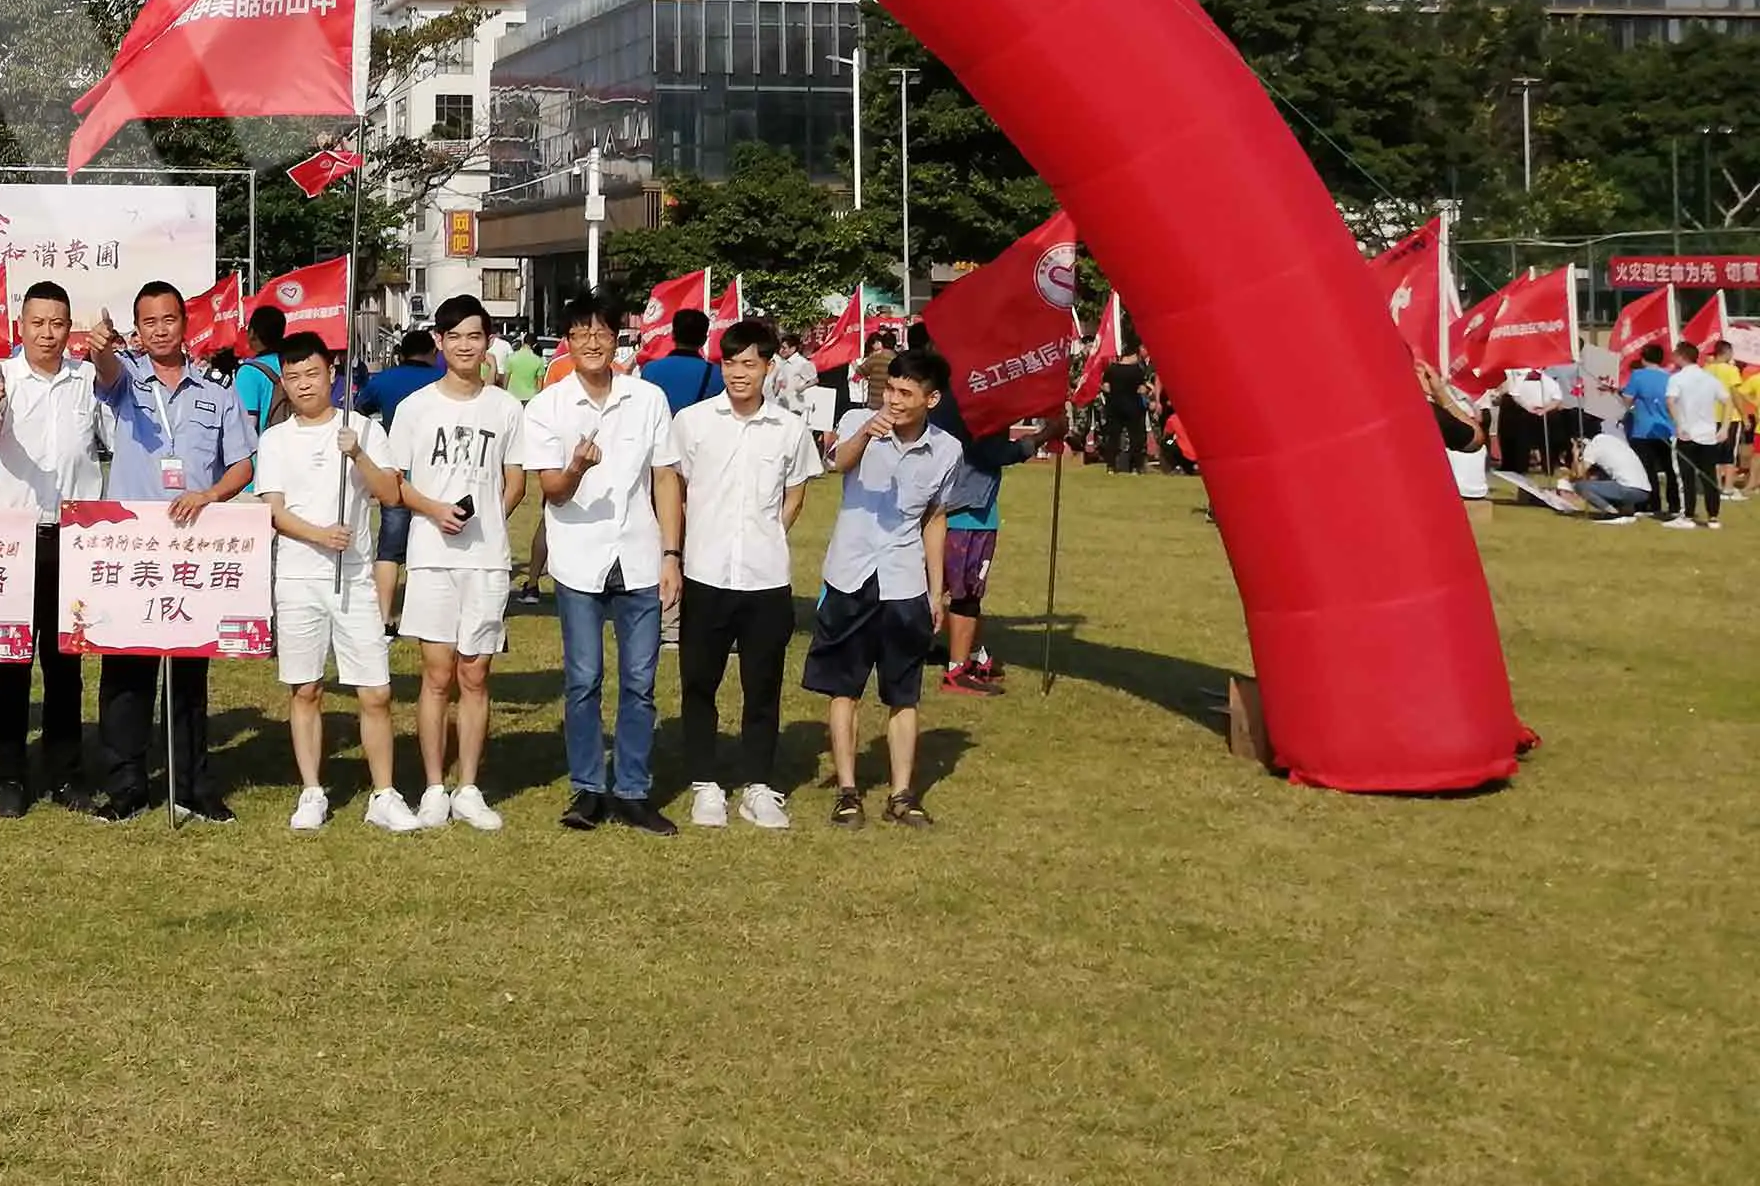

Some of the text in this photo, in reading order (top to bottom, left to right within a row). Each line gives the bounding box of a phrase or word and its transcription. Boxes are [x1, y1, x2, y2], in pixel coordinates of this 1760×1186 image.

[430, 425, 497, 468] ART
[91, 560, 244, 590] 甜美电器
[144, 595, 193, 623] 1队
